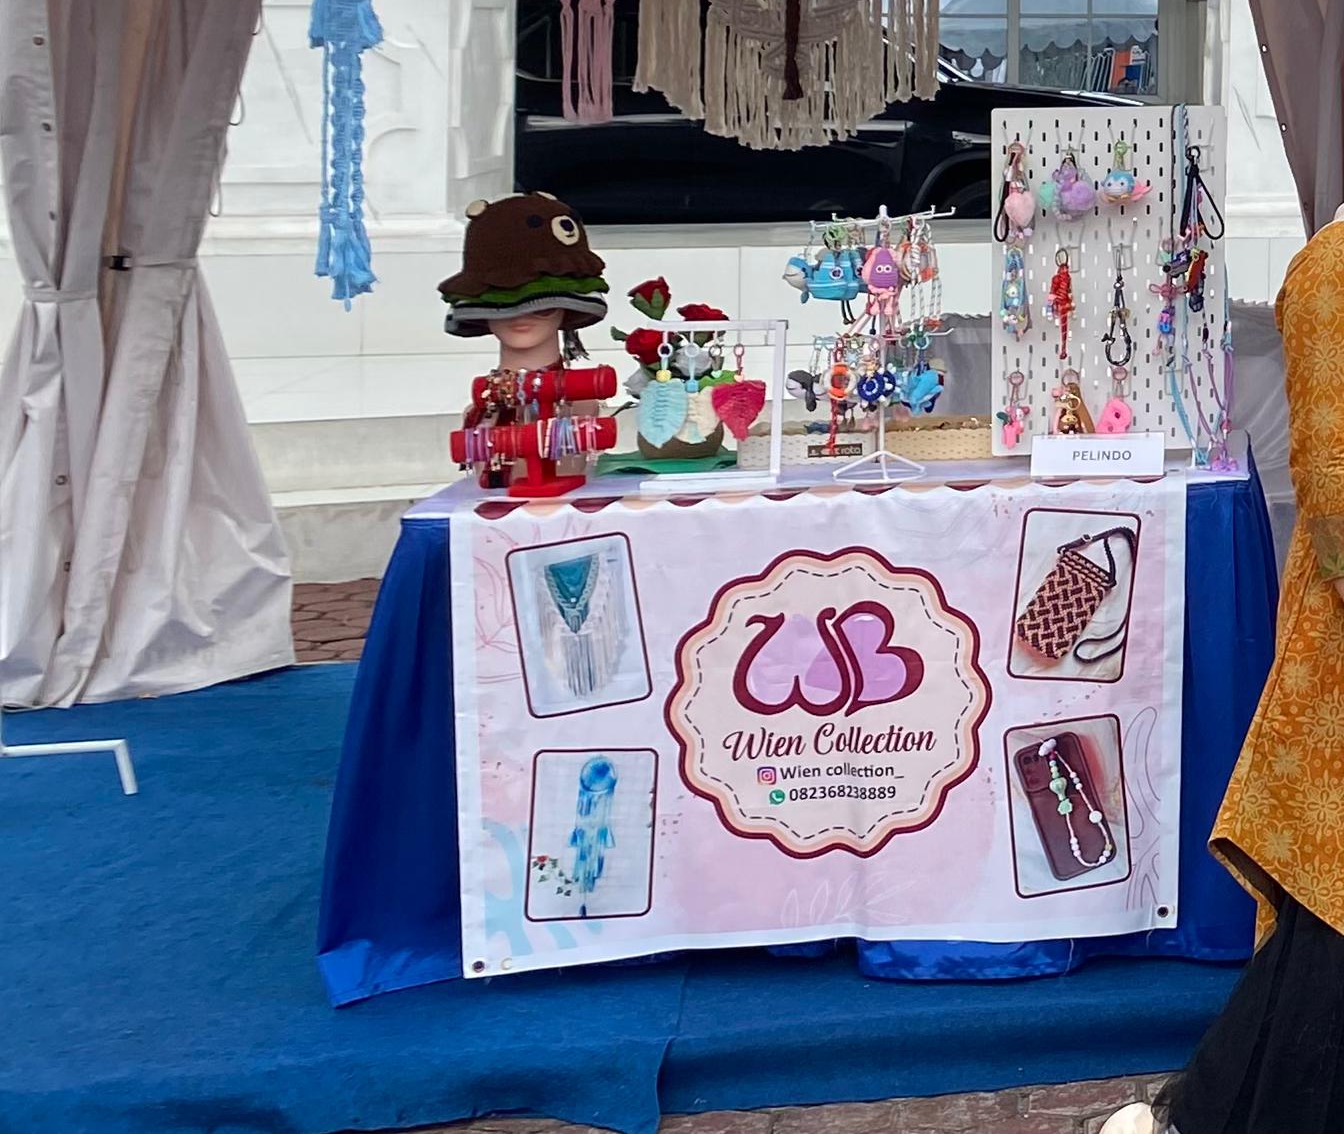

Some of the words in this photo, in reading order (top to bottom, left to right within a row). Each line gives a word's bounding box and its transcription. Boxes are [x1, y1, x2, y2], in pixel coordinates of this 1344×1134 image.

[1072, 450, 1132, 461] PELINDO
[722, 726, 806, 761] Wien
[813, 722, 937, 755] Collection
[780, 766, 821, 780] Wien
[789, 785, 896, 801] 082368238889
